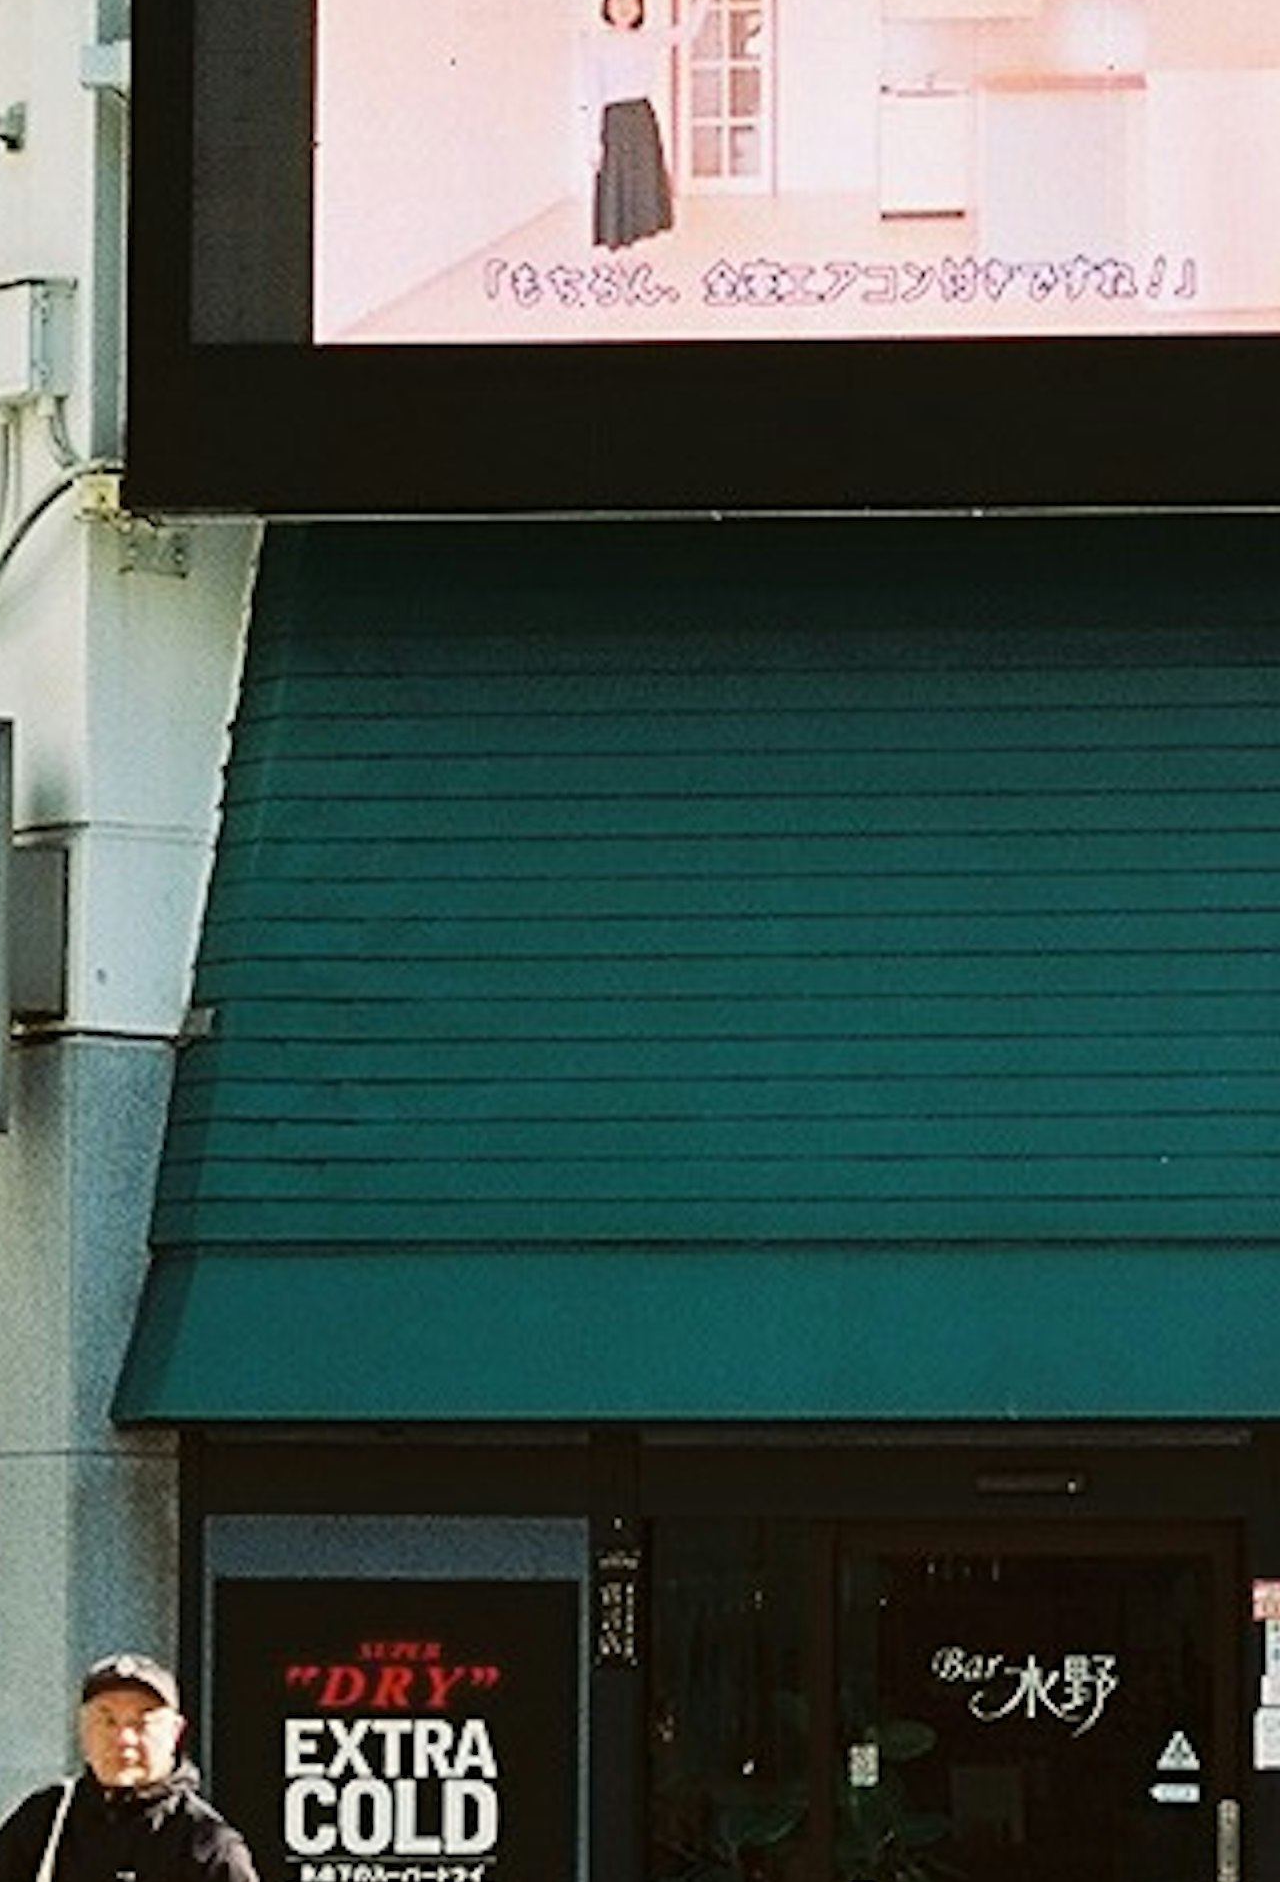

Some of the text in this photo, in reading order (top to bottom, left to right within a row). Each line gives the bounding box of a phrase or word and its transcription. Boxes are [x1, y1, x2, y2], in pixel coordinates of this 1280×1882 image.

[930, 1646, 1004, 1682] Bar
[968, 1654, 1120, 1740] 水野
[283, 1718, 499, 1779] EXTRA
[283, 1777, 499, 1856] COLD
